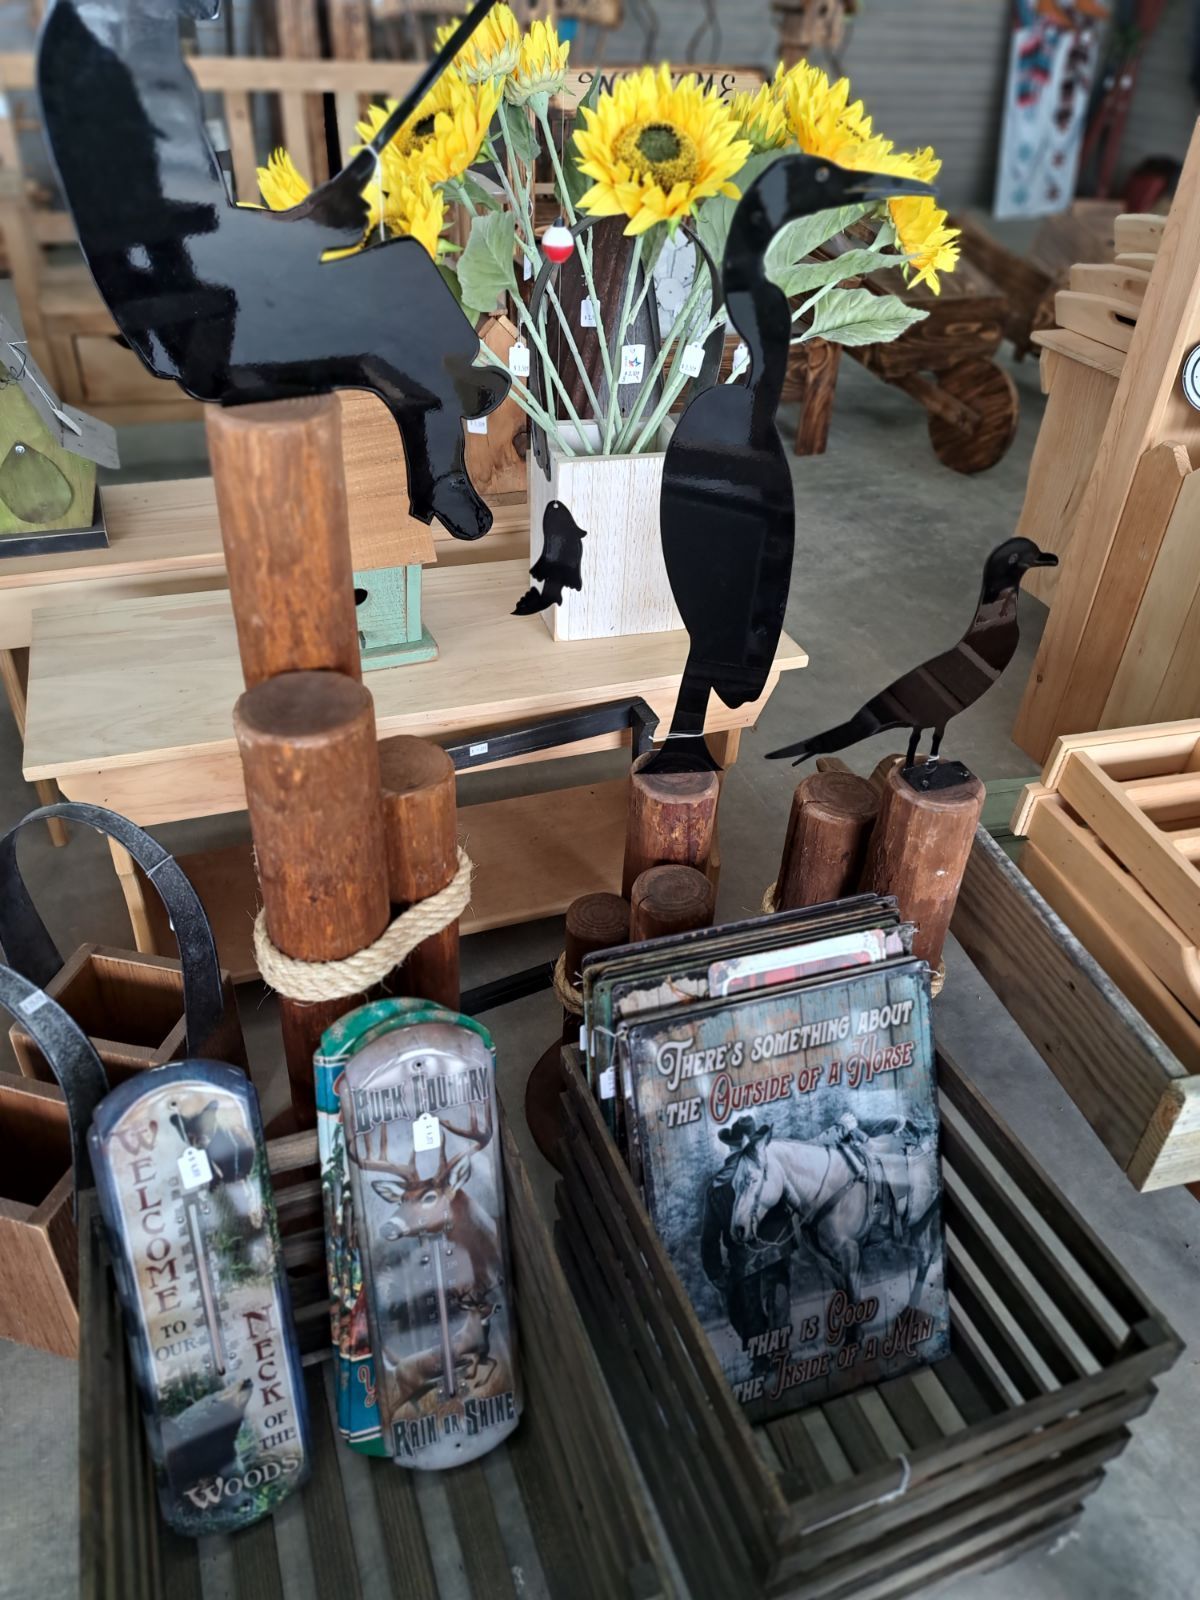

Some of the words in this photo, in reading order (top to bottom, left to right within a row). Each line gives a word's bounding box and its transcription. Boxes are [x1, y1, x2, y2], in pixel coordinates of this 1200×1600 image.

[656, 1038, 743, 1091] THERE'S
[751, 1015, 849, 1062] SOMETHING
[857, 1000, 914, 1035] ABOUT
[351, 1082, 410, 1135] BUCK
[411, 1066, 491, 1119] COUNTRY
[666, 1097, 701, 1128] THE
[710, 1072, 792, 1124] OUTSIDE
[798, 1066, 823, 1093] OF
[828, 1062, 841, 1086] A
[847, 1034, 914, 1088] HORSE
[111, 1120, 182, 1314] WELCOME
[154, 1339, 197, 1361] OUR
[160, 1320, 188, 1339] TO
[243, 1304, 285, 1408] NECK
[733, 1376, 765, 1402] THE
[769, 1351, 830, 1398] INSIDE
[836, 1345, 858, 1369] OF
[864, 1338, 878, 1361] A
[881, 1307, 934, 1358] MAN
[748, 1326, 792, 1358] THAT
[801, 1316, 819, 1342] IS
[826, 1289, 879, 1345] GOOD
[259, 1427, 296, 1451] THE
[264, 1410, 288, 1430] OF
[391, 1414, 439, 1457] RAIN
[443, 1415, 463, 1434] OR
[464, 1391, 516, 1436] SHINE
[183, 1454, 299, 1510] WOODS
